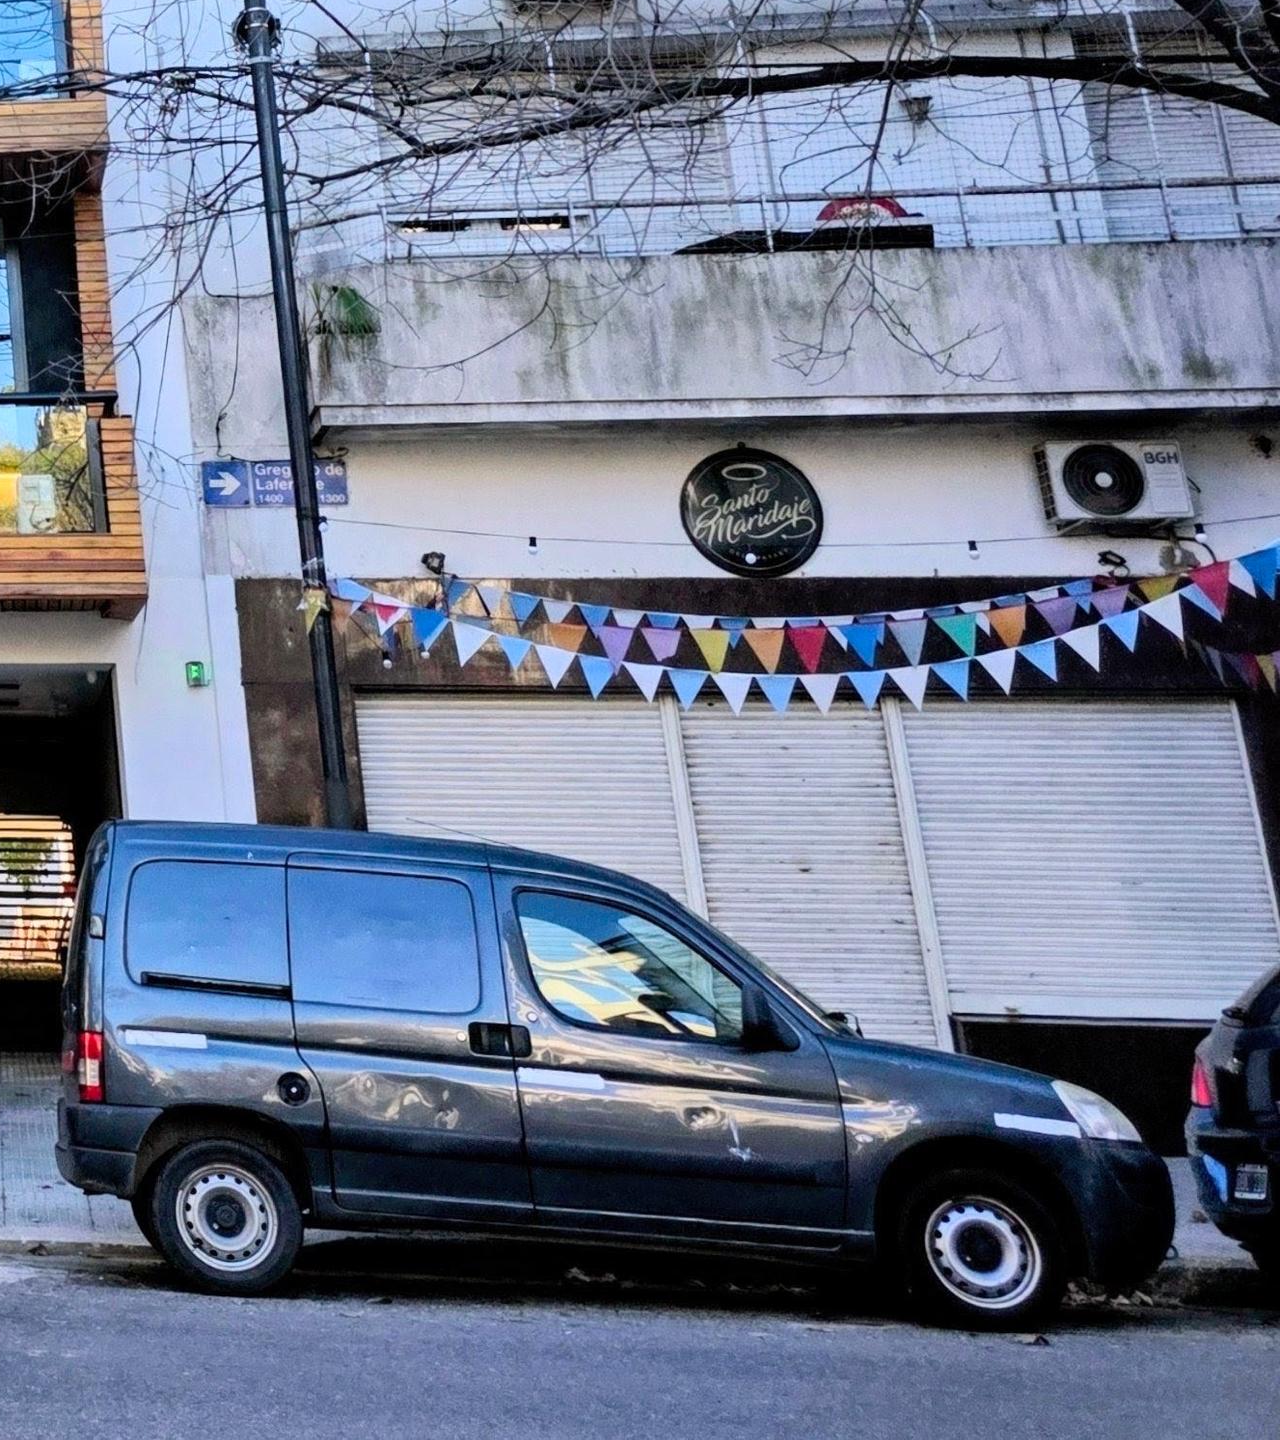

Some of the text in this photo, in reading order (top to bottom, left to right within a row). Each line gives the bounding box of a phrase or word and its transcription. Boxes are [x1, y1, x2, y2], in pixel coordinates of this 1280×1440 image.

[1143, 451, 1179, 465] BGH
[324, 463, 345, 476] de
[258, 494, 284, 503] 1400
[320, 494, 345, 503] 1300
[697, 481, 772, 526] Santo
[693, 497, 814, 547] Maridaje
